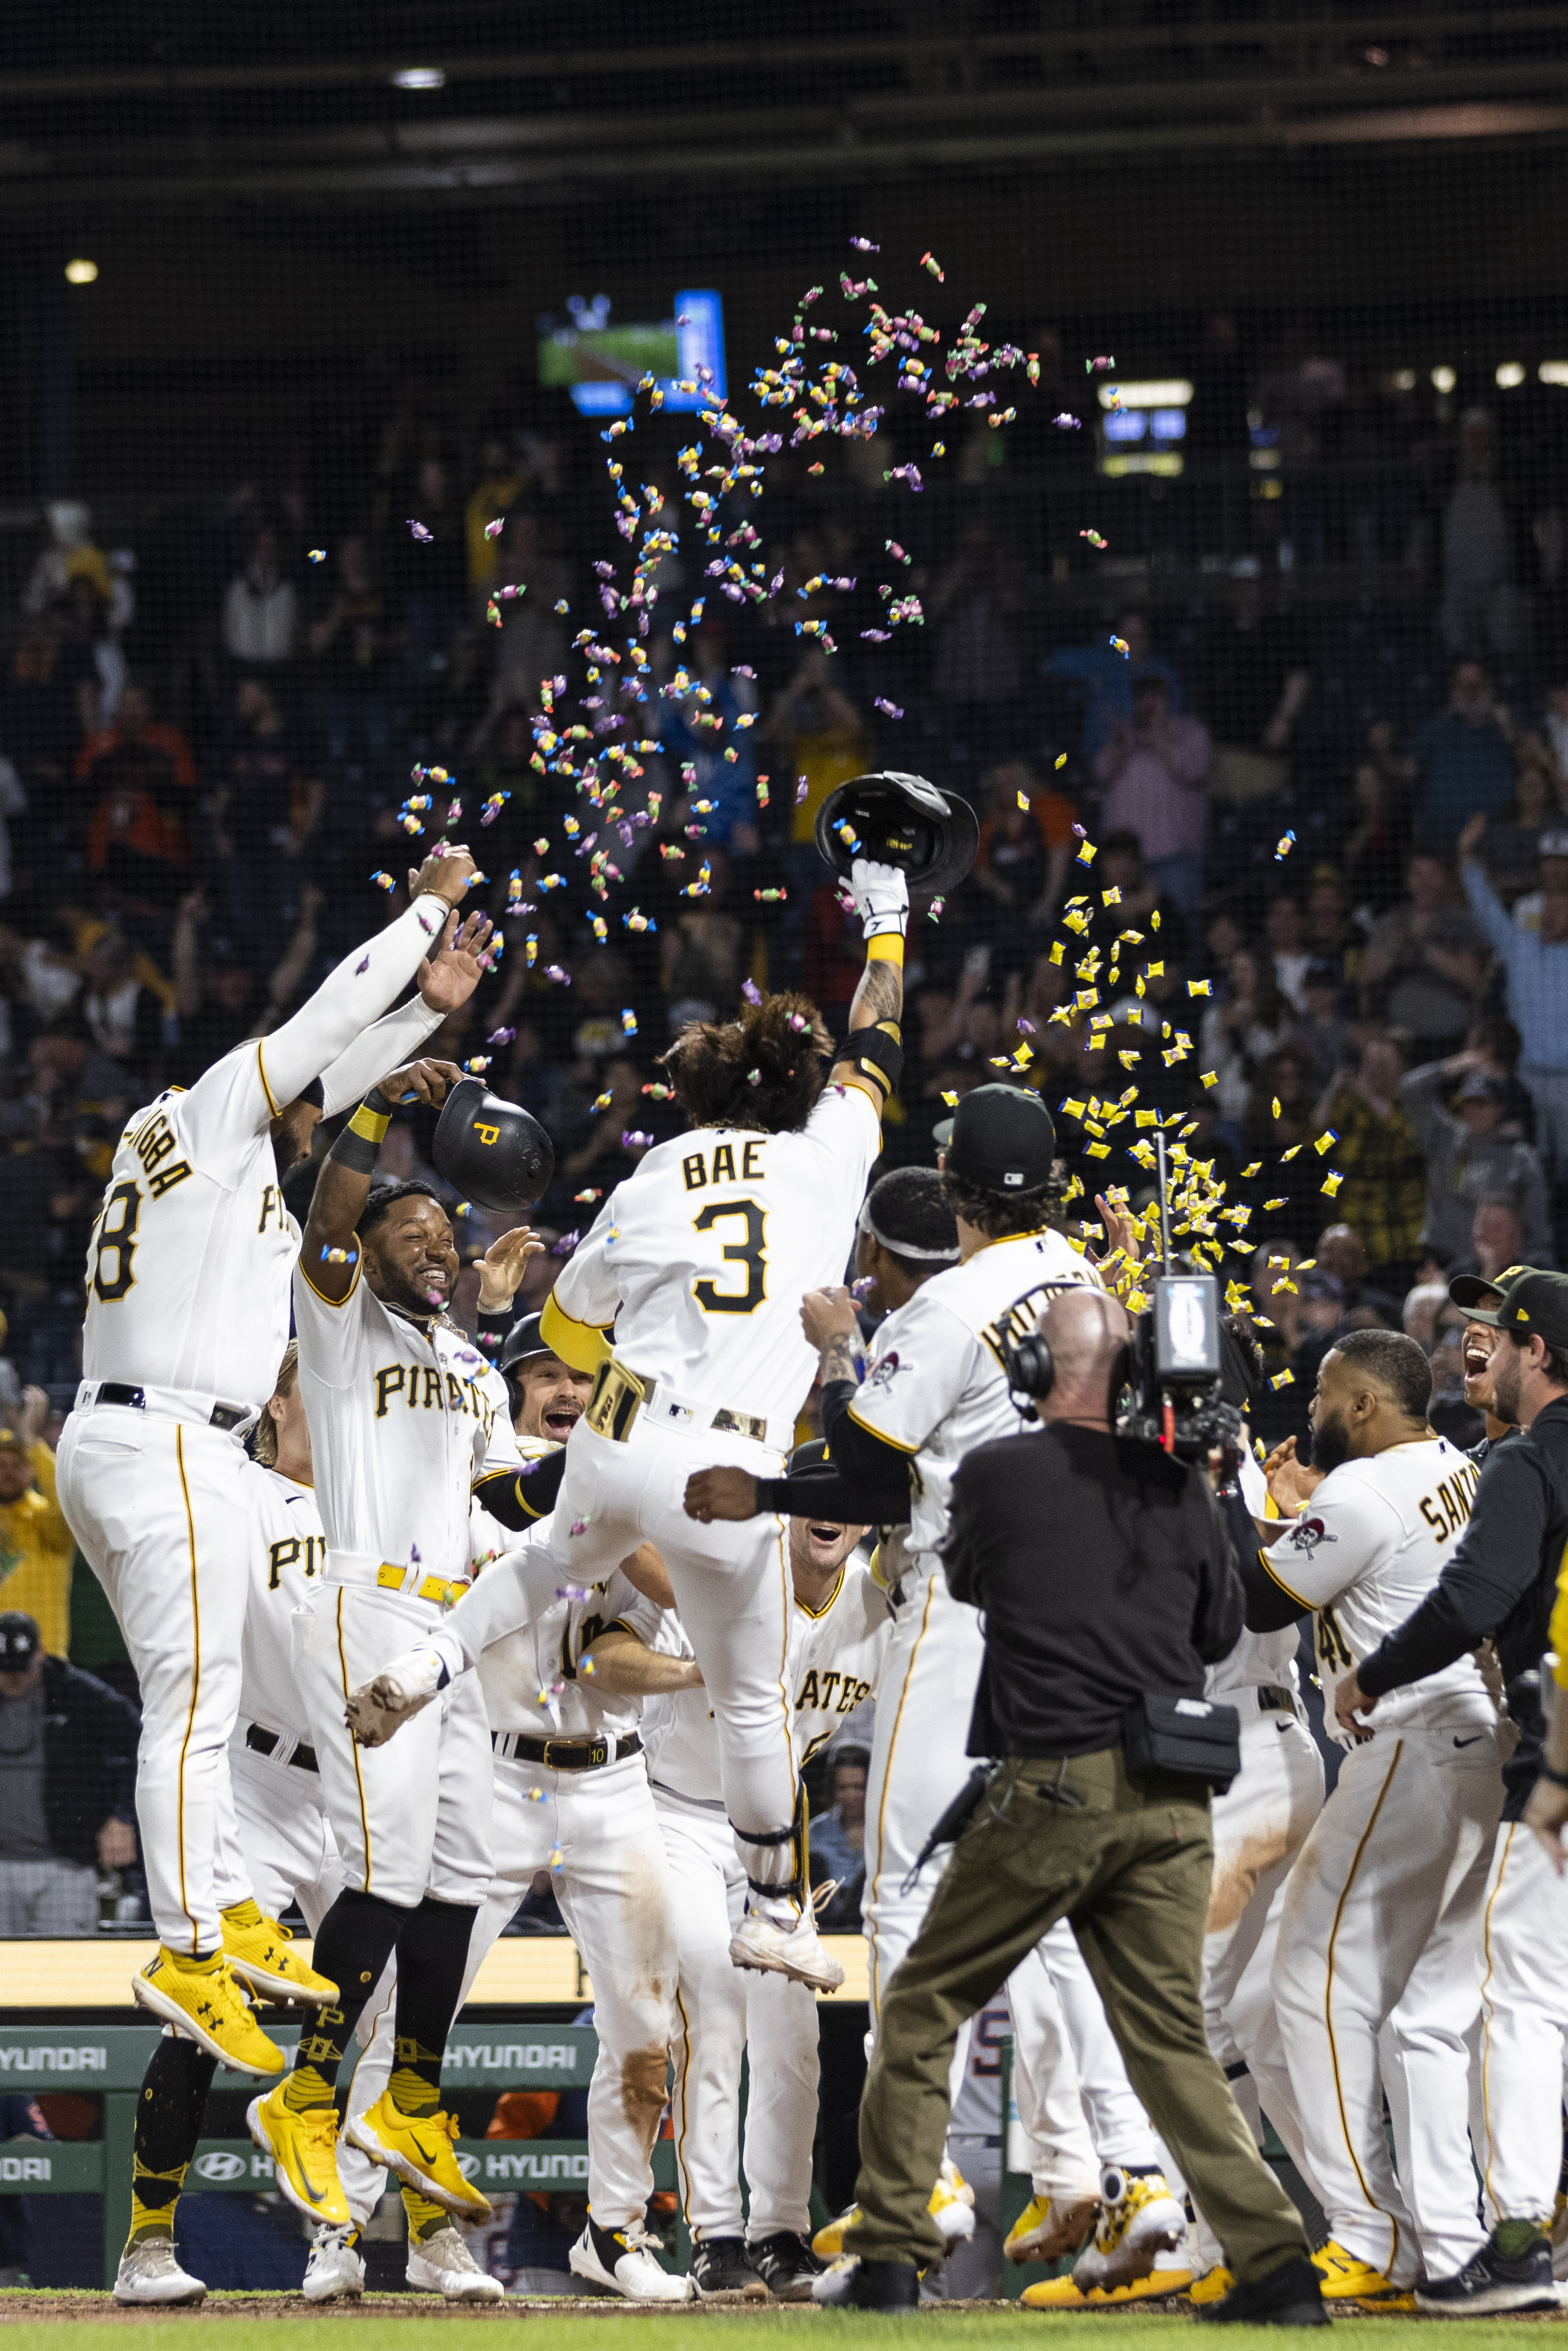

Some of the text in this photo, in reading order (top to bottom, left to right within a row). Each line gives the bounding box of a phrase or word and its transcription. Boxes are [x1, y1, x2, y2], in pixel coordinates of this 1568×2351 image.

[473, 1122, 501, 1145] P
[681, 1140, 768, 1191] BAE
[258, 1183, 290, 1234] PI
[86, 1179, 144, 1305] 8
[690, 1197, 770, 1315] 3
[591, 1748, 604, 1763] 10
[442, 2044, 576, 2069] HYUNDAI
